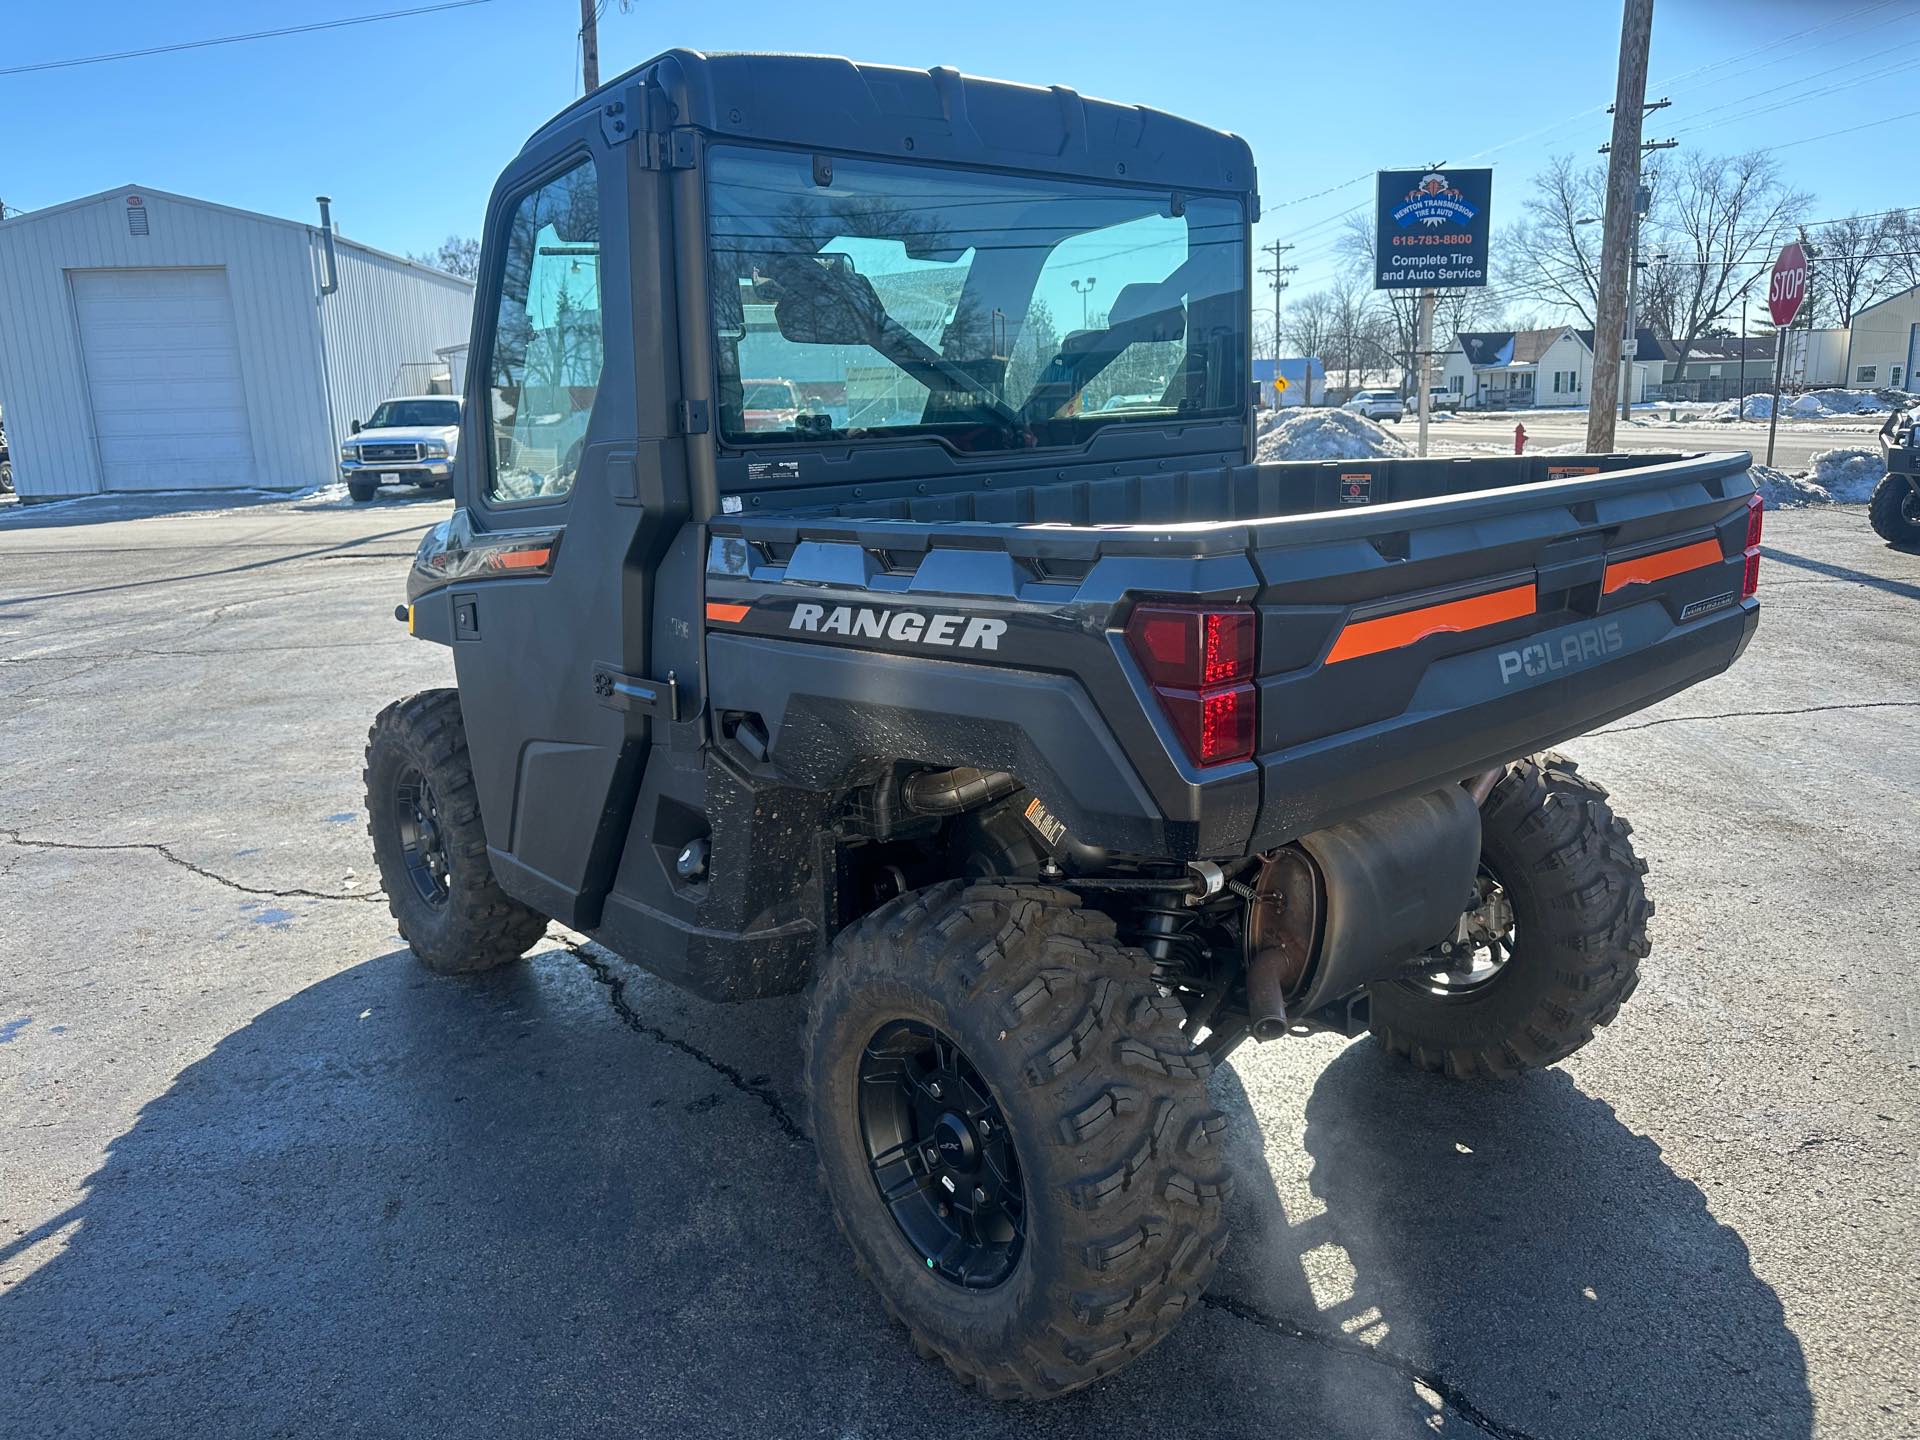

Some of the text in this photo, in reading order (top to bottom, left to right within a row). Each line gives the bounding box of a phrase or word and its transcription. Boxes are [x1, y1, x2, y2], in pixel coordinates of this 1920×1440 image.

[1394, 199, 1474, 220] NEWTON TRANSMISSION
[1415, 208, 1429, 218] TIRE
[1436, 208, 1453, 217] AUTO
[1392, 234, 1472, 245] 618-783-8800
[1392, 253, 1474, 267] Complete Tire
[1382, 267, 1482, 280] and Auto Service
[1771, 267, 1804, 302] STOP
[788, 602, 1008, 651] RANGER
[1498, 621, 1623, 685] POLARIS
